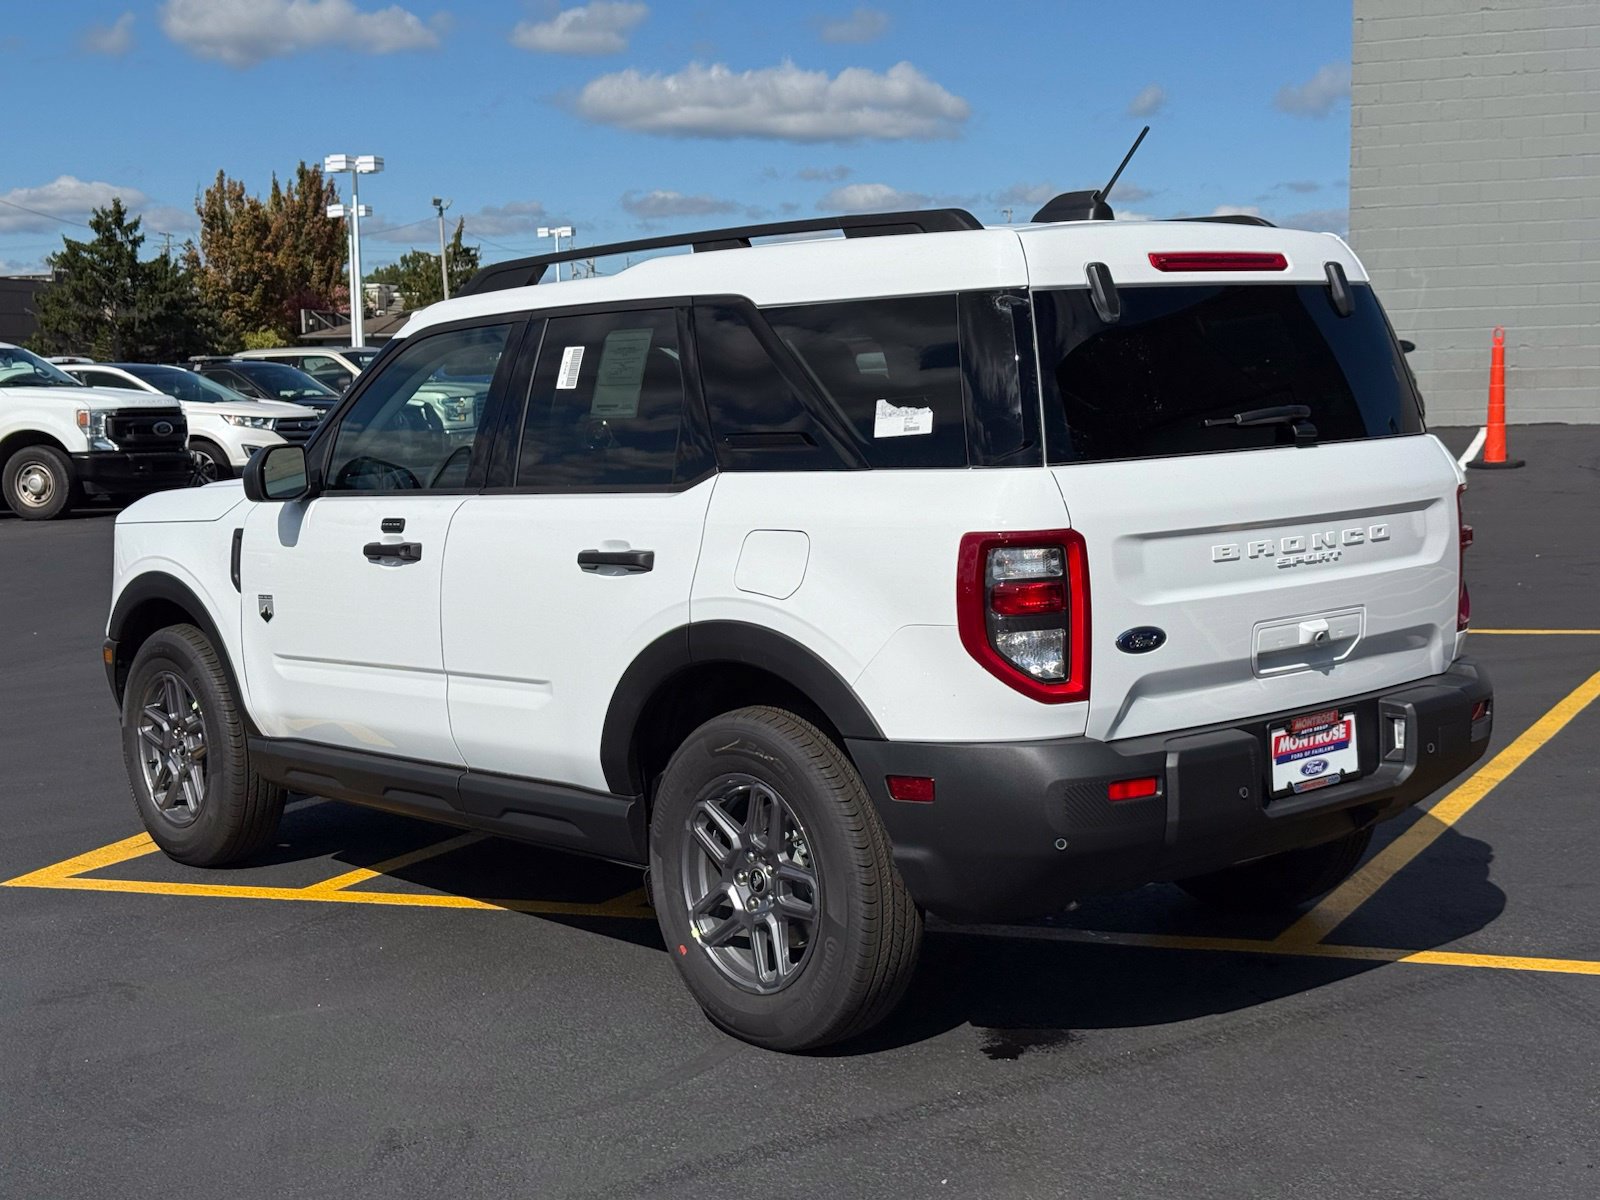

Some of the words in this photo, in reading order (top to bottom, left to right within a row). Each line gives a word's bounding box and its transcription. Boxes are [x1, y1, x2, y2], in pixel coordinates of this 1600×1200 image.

[1212, 524, 1390, 562] BRONCO
[1277, 550, 1342, 568] SPORT
[1294, 713, 1335, 728] MONTROSE
[1278, 724, 1346, 753] MONTROSE
[1291, 751, 1303, 760] FORD
[1304, 749, 1311, 757] OF
[1312, 745, 1335, 755] FAIRLAWN
[1305, 761, 1324, 775] Ford
